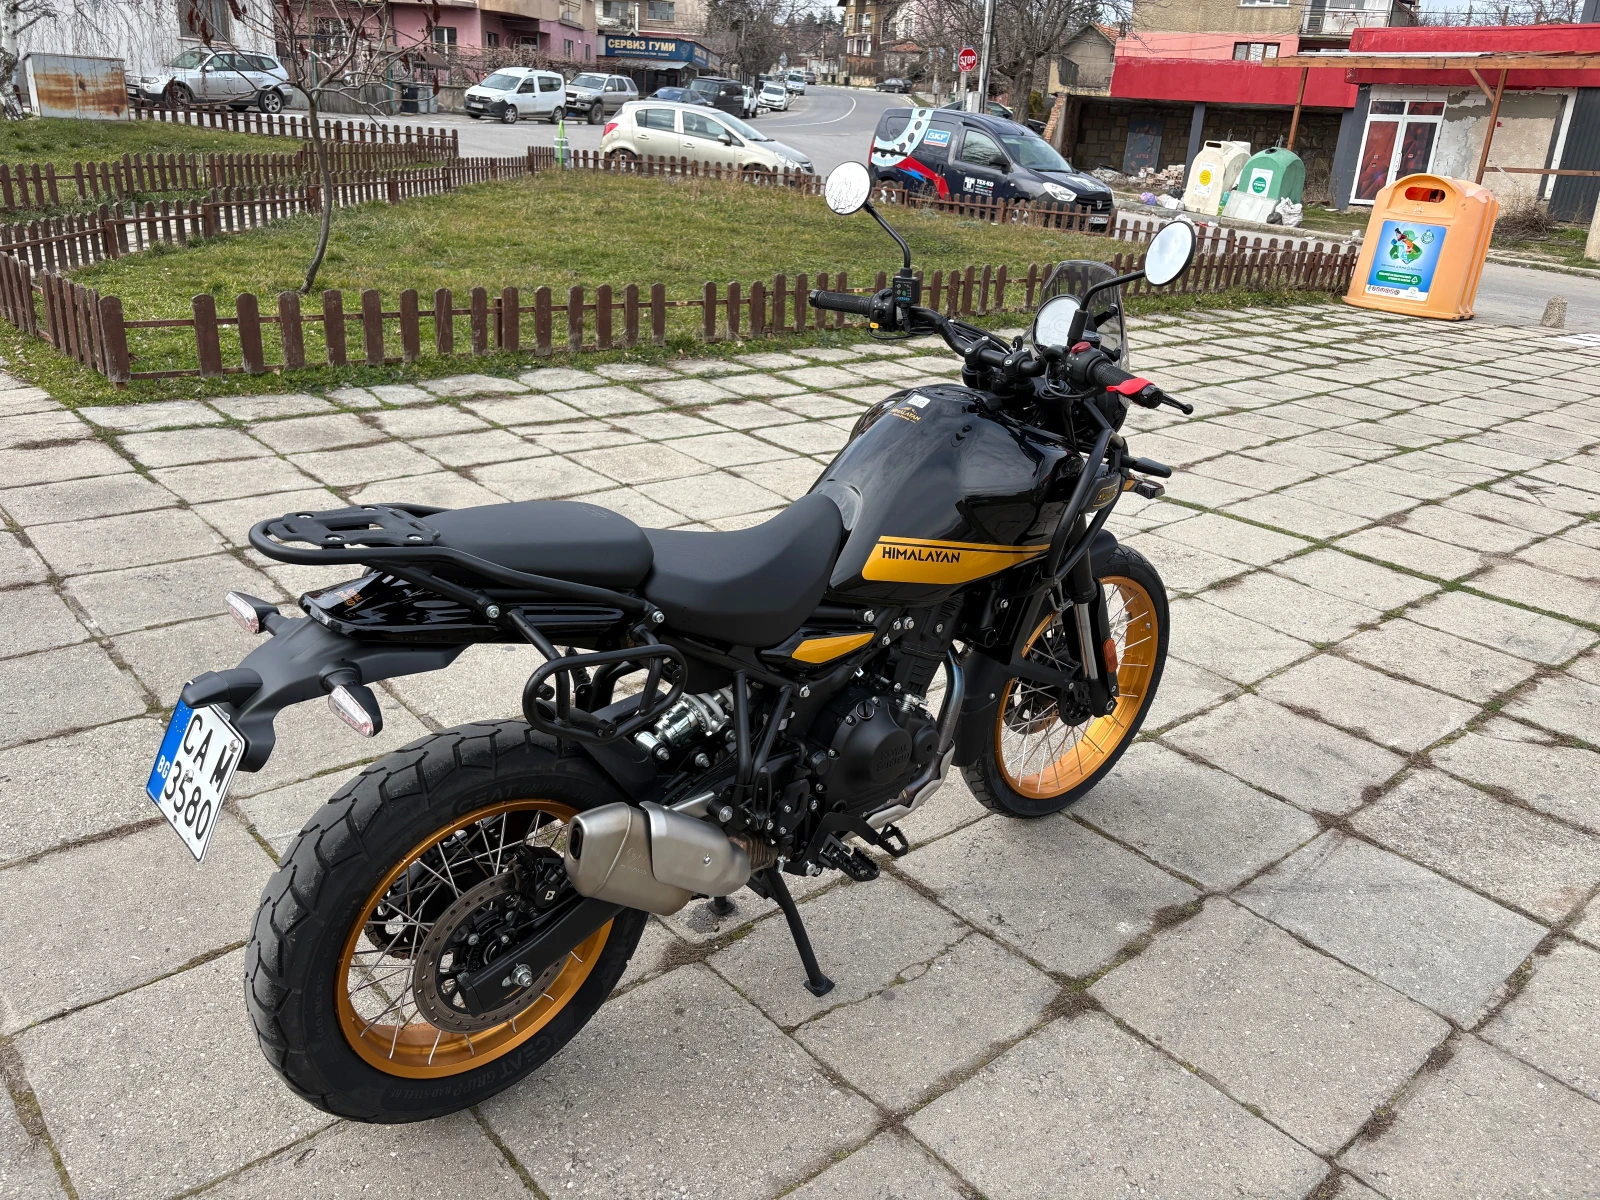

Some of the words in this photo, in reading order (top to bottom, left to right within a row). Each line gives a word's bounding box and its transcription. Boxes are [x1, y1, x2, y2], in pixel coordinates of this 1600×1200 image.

[607, 38, 646, 50] СЕРВИЗ
[648, 41, 676, 52] ГУМИ
[960, 55, 976, 66] STOP
[927, 132, 948, 141] SKF
[882, 546, 960, 563] HIMALAYAN
[156, 754, 171, 779] BG
[183, 713, 213, 772] CA
[209, 744, 235, 794] M
[164, 760, 212, 840] 3580
[457, 784, 518, 813] CEAT
[499, 1035, 551, 1079] CEAT
[453, 1070, 496, 1097] GRIPP
